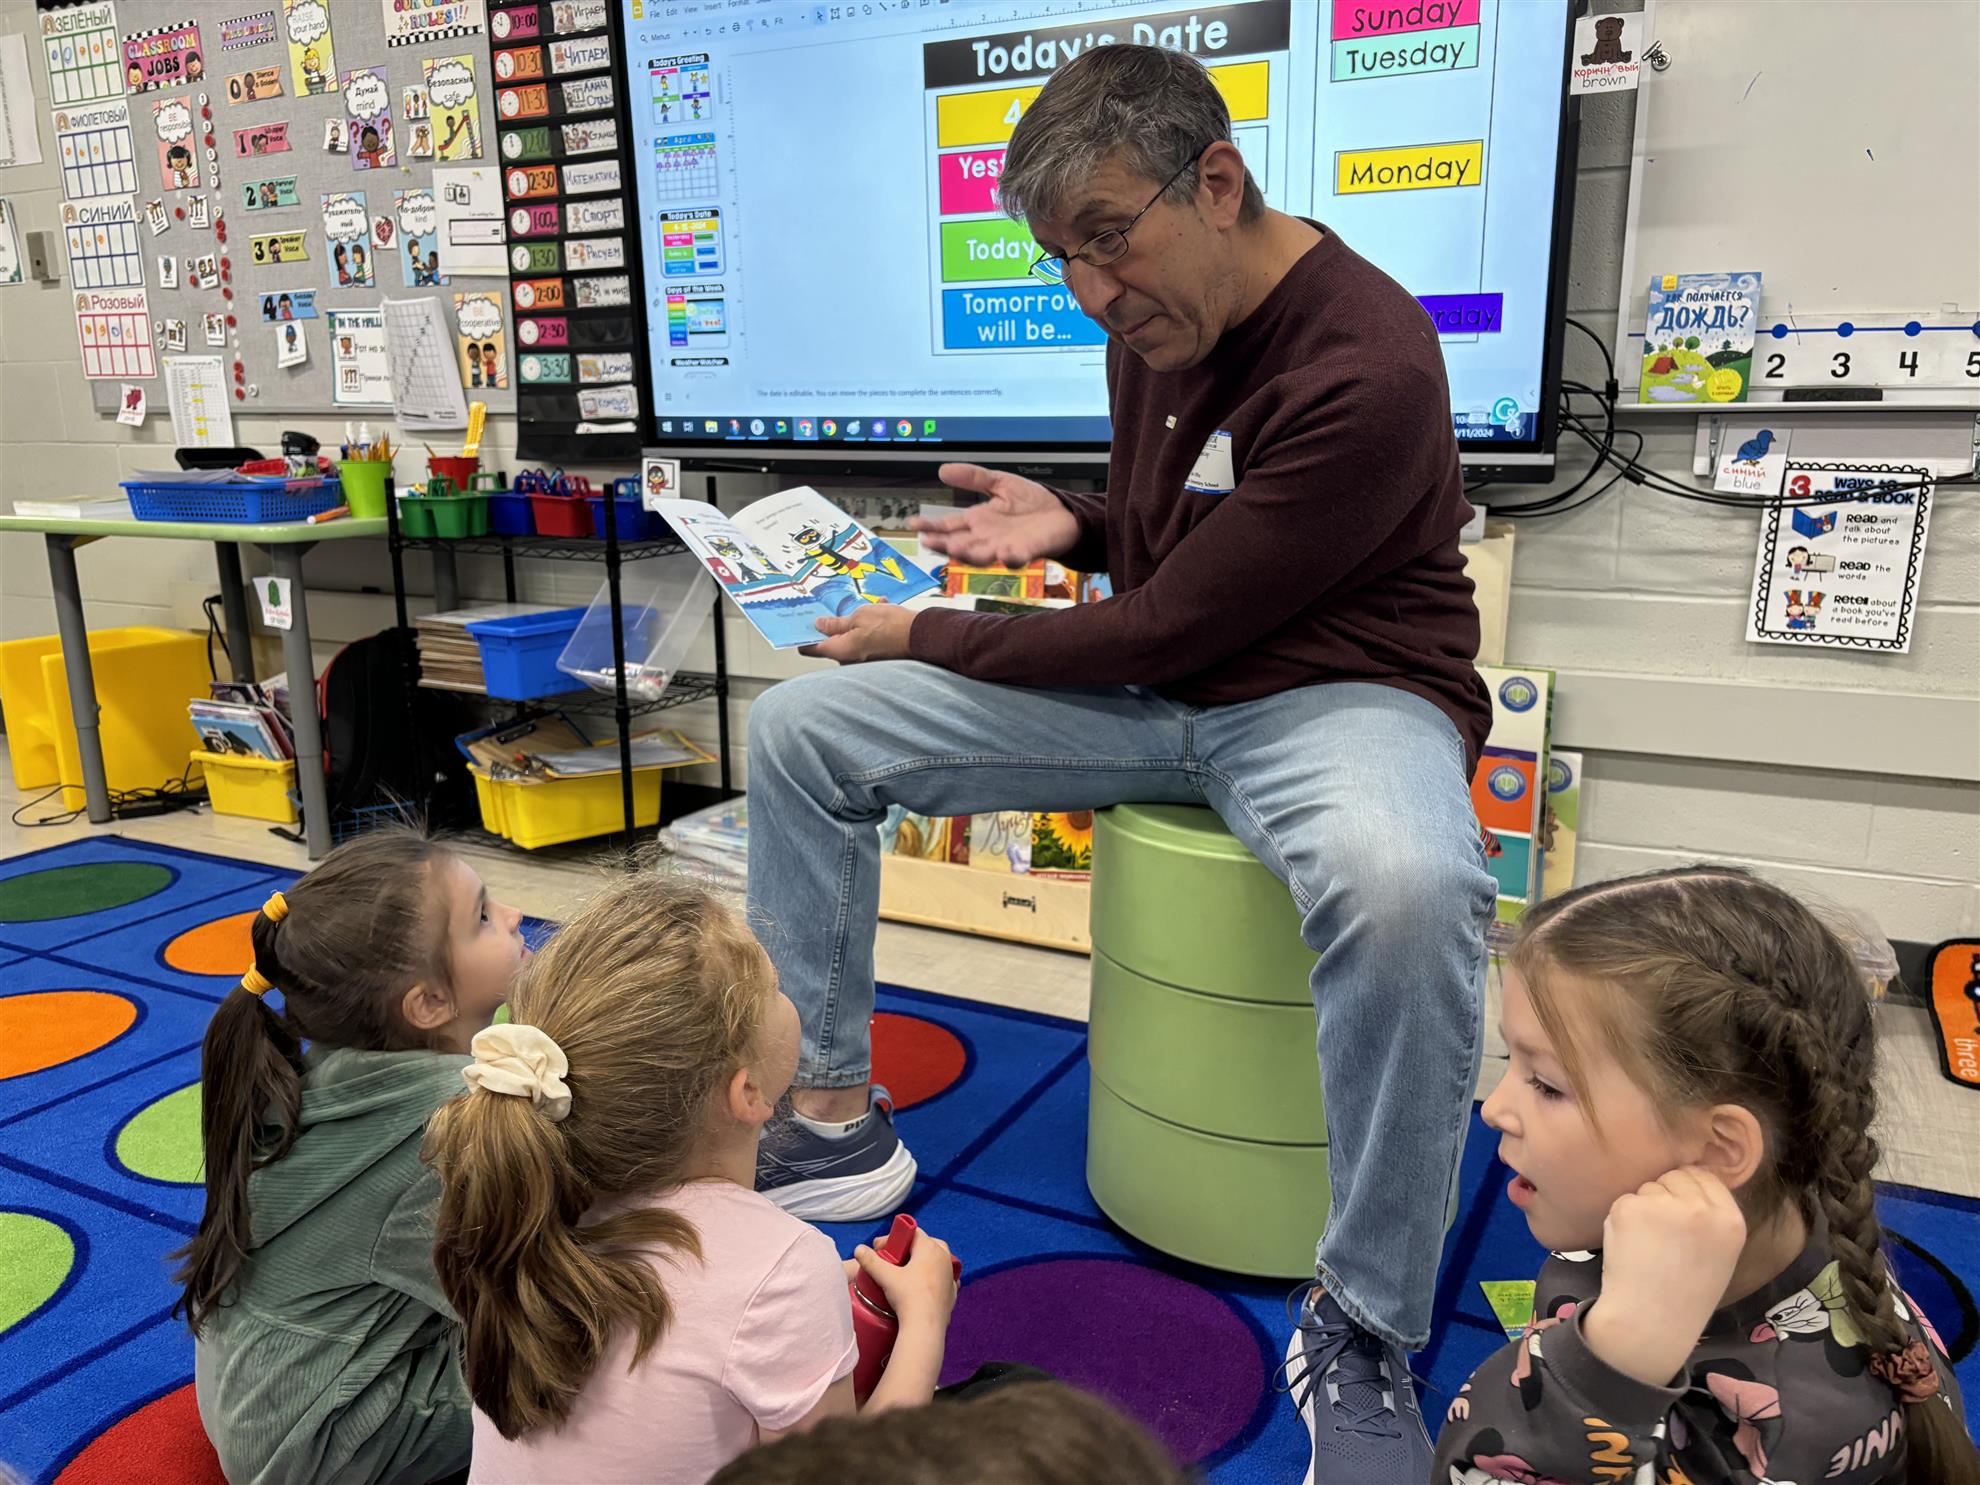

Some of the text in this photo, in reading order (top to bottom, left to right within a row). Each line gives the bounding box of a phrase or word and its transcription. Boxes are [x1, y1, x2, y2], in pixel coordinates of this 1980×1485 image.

[55, 7, 112, 32] ЗЕЛЁНЫЙ
[308, 19, 326, 32] hand
[512, 13, 537, 29] 10:00
[1351, 0, 1463, 32] Sunday
[1133, 15, 1229, 52] Date
[127, 33, 197, 60] CLASSROOM
[147, 56, 181, 77] JOBS
[1346, 41, 1466, 74] Tuesday
[1582, 75, 1627, 88] brown
[70, 109, 127, 128] ФИОЛЕТОВЫЙ
[1351, 157, 1471, 187] Monday
[246, 186, 256, 206] 2
[79, 201, 133, 224] СИНИЙ
[254, 241, 264, 261] 3
[966, 237, 1037, 263] Today
[263, 294, 277, 320] 4
[962, 293, 1081, 315] Tomorrow
[460, 317, 502, 329] cooperative
[1654, 304, 1750, 336] ДОЖДЬ?
[977, 319, 1016, 342] will
[542, 358, 570, 378] 3:30
[1765, 351, 1980, 378] 2 3 4 5
[1723, 467, 1767, 479] синий
[1733, 476, 1761, 491] blue
[1789, 474, 1811, 498] 3
[1843, 535, 1900, 546] the pictures
[1864, 527, 1891, 535] about
[1875, 565, 1891, 573] the
[1840, 606, 1863, 615] book
[1865, 609, 1896, 618] you've
[1870, 599, 1897, 607] about
[1830, 616, 1888, 627] read before
[1953, 1037, 1978, 1078] three
